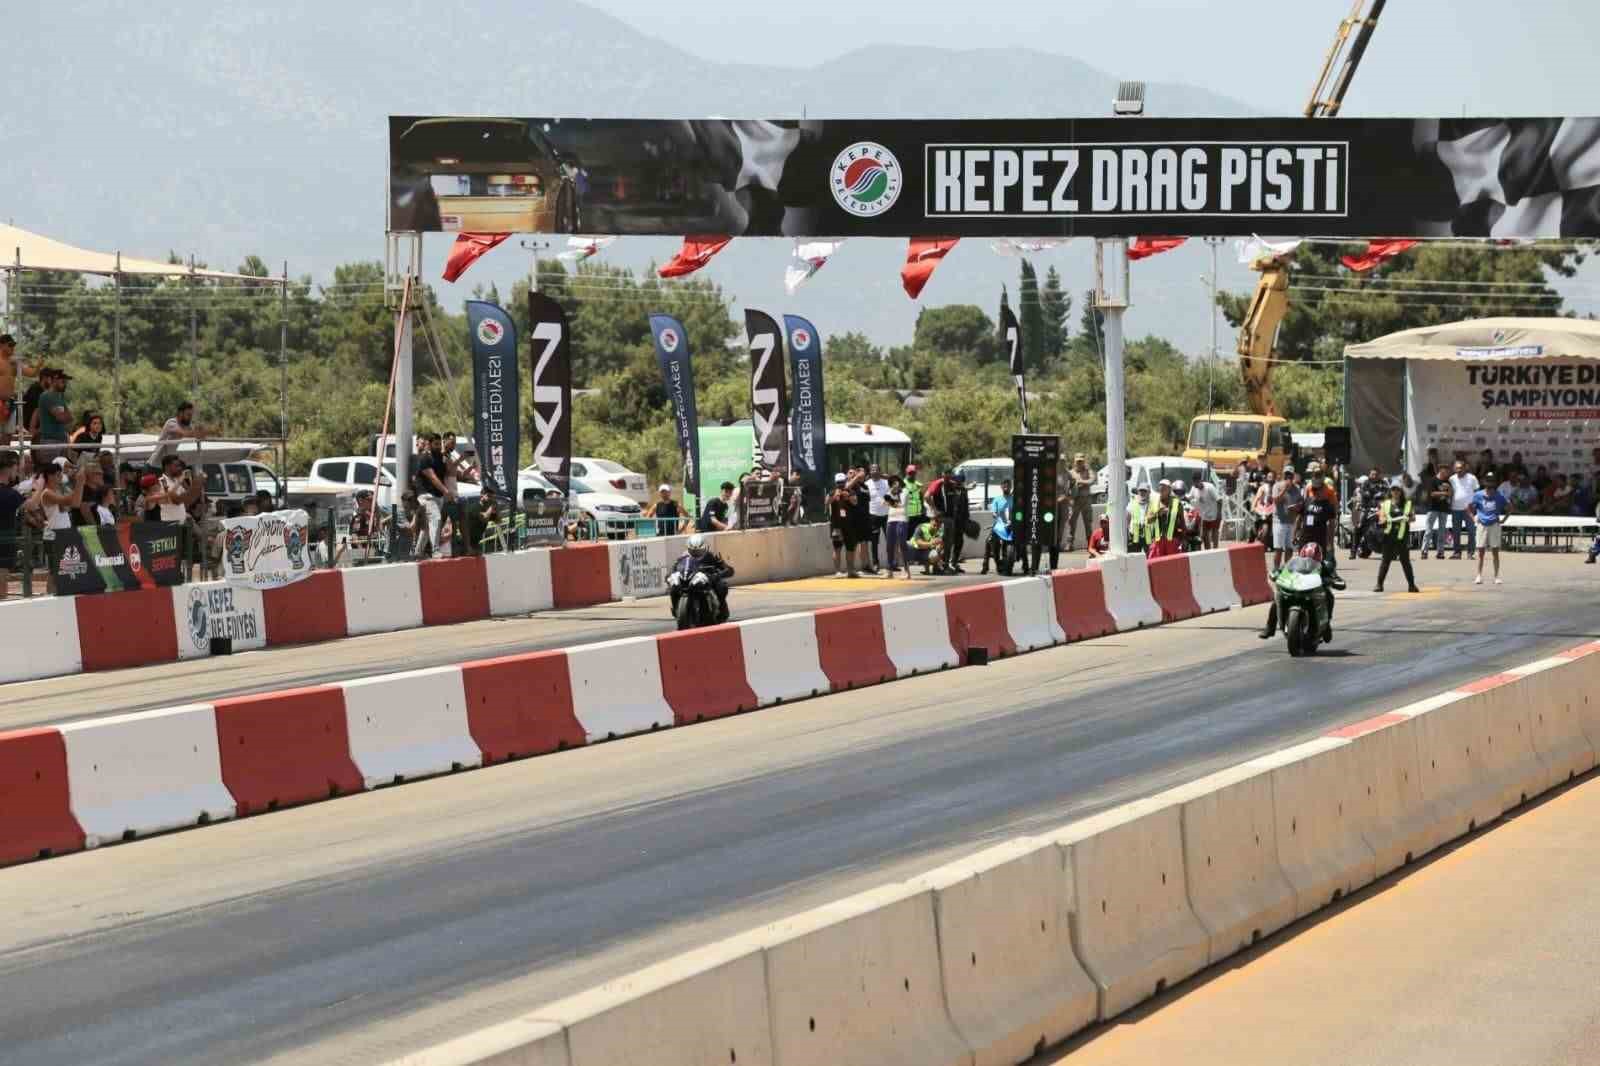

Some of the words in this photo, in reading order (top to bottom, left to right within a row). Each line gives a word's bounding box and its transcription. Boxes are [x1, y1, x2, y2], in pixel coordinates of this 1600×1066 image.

[838, 148, 893, 171] KEPEZ
[935, 150, 1079, 212] KEPEZ
[1091, 149, 1207, 211] DRAG
[208, 587, 234, 613] KEPEZ
